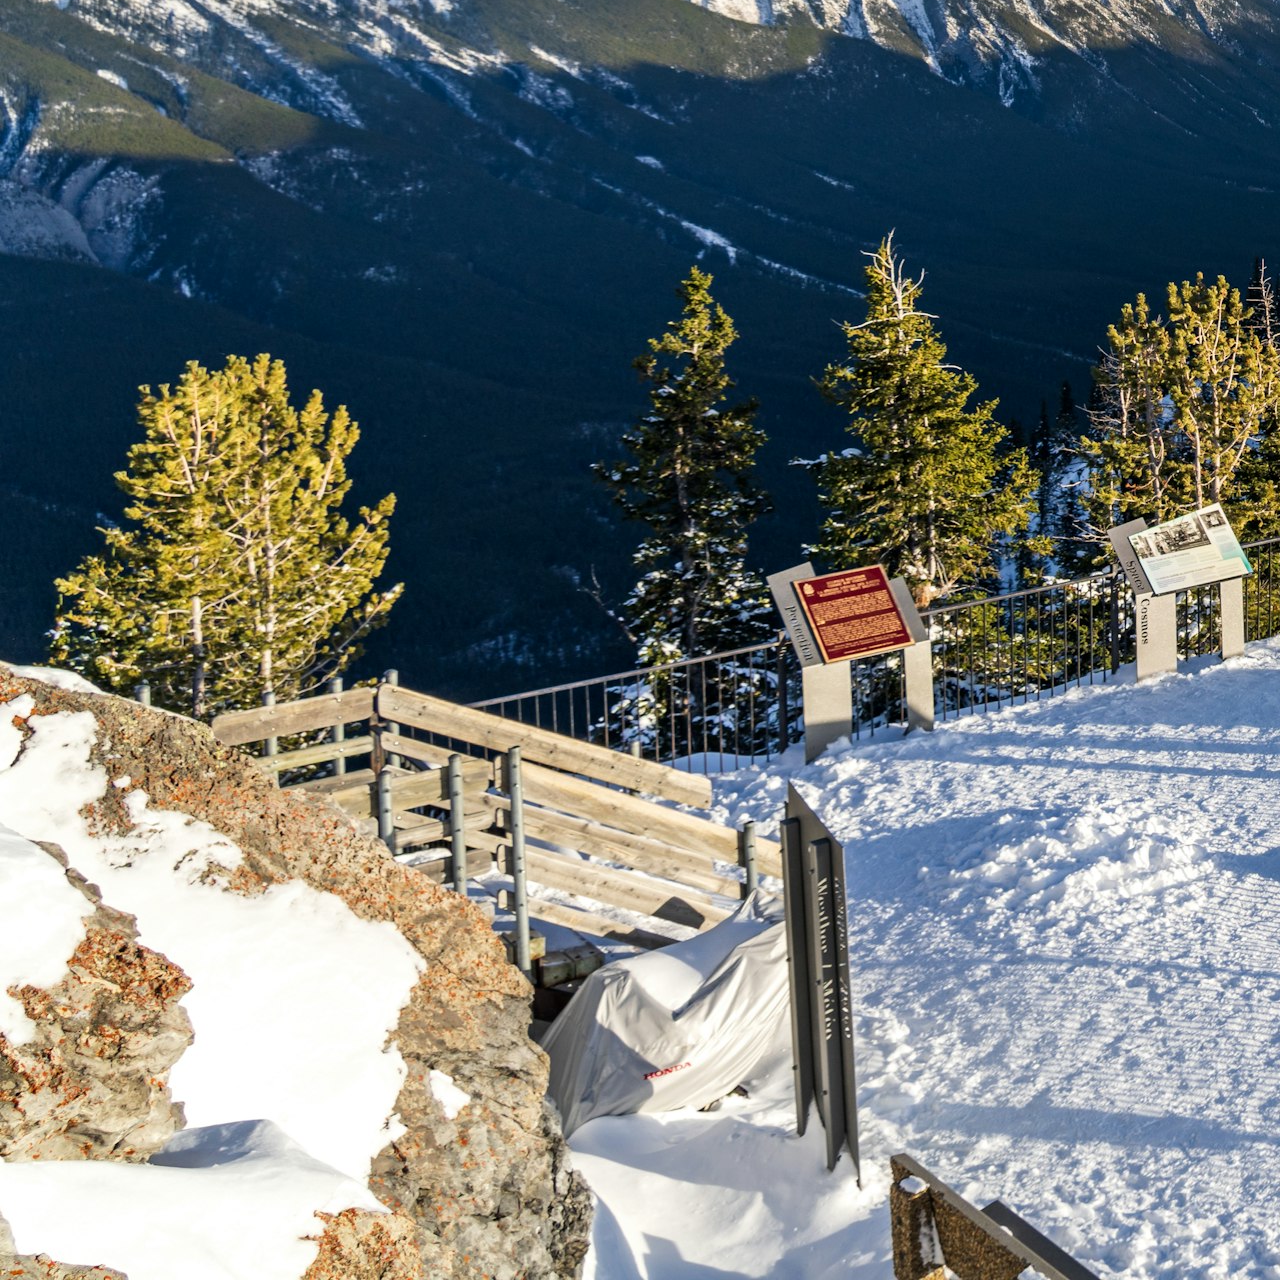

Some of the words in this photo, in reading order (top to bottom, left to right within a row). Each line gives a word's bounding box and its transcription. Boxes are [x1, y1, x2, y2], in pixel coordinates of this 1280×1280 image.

[1125, 560, 1144, 591] Space
[784, 604, 813, 661] Protection
[1141, 599, 1150, 645] Cosmos
[643, 1062, 692, 1081] HONDA
